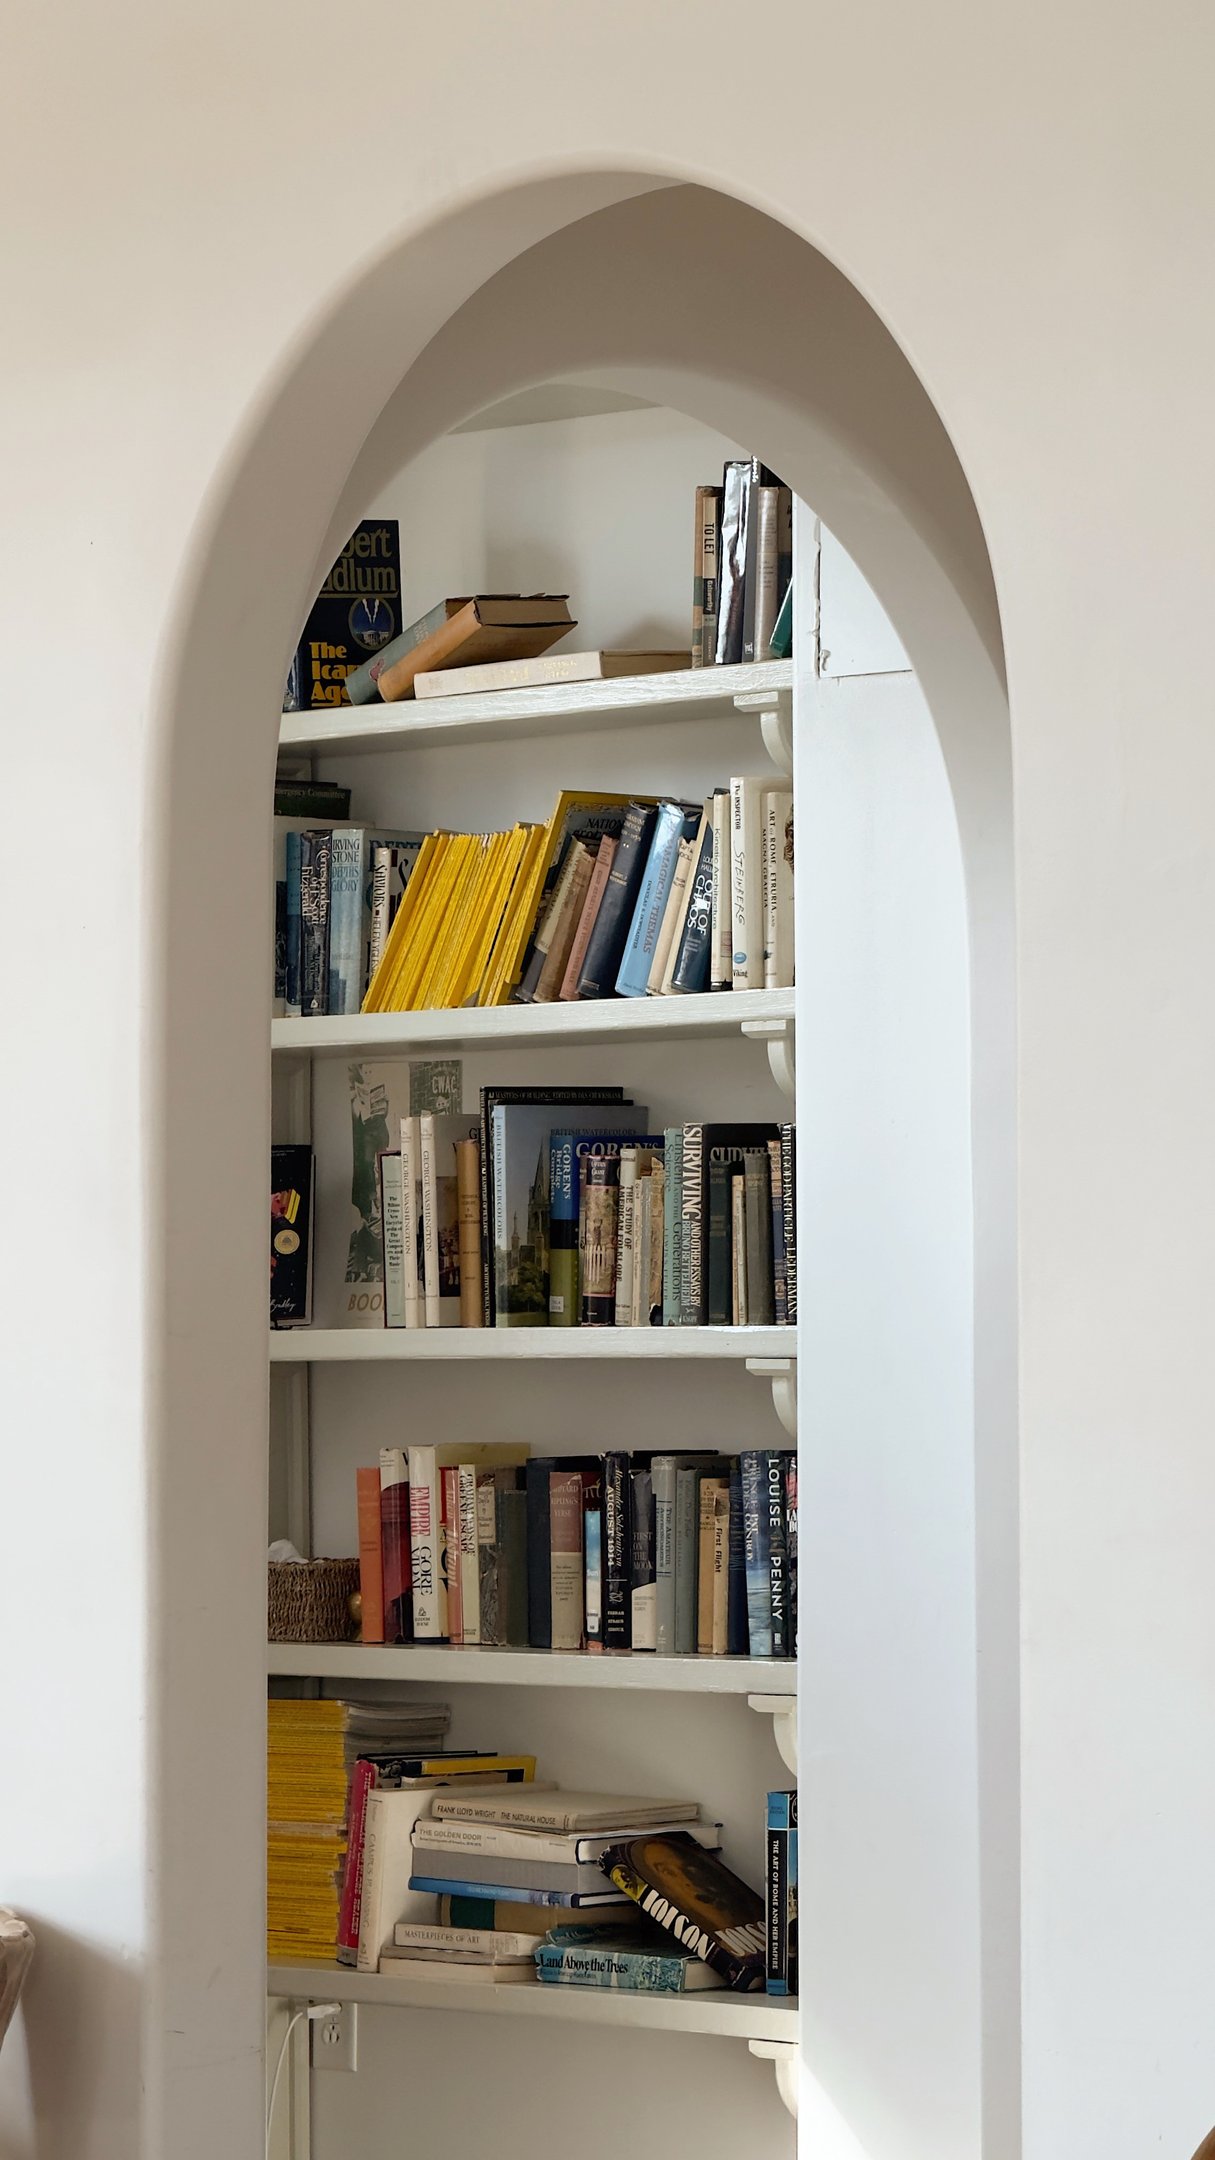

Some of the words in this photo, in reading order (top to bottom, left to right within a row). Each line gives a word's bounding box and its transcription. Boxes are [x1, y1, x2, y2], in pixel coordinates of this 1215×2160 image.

[704, 522, 715, 534] TO
[704, 537, 715, 555] LET
[309, 641, 347, 659] The
[332, 851, 360, 863] STONE
[333, 839, 360, 851] IRVING
[714, 828, 722, 864] Kinetic
[301, 866, 314, 917] Fitzgerald
[316, 850, 330, 925] Correspondence
[332, 880, 358, 892] GLORY
[701, 880, 714, 914] OUT
[713, 866, 721, 930] Architecture
[311, 899, 322, 925] Scott
[687, 875, 705, 929] CHAOS
[643, 904, 660, 953] THEMAS
[697, 914, 709, 935] OF
[733, 970, 748, 978] Viking
[431, 1075, 458, 1093] CWAC
[495, 1125, 503, 1165] BRITISH
[781, 1131, 791, 1154] THE
[423, 1150, 431, 1186] GEORGE
[563, 1144, 572, 1199] GOREN'S
[664, 1143, 674, 1193] Science
[674, 1134, 683, 1185] Einstein
[682, 1126, 703, 1220] SURVIVING
[782, 1156, 792, 1182] GOD
[625, 1185, 634, 1202] THE
[403, 1191, 411, 1254] WASHINGTON
[424, 1189, 433, 1252] WASHINGTON
[624, 1206, 634, 1235] STUDY
[782, 1185, 794, 1243] PARTICLE
[681, 1220, 691, 1250] BRUNO
[690, 1221, 701, 1236] AND
[624, 1237, 633, 1250] OF
[690, 1236, 701, 1264] OTHER
[672, 1220, 683, 1301] Generations
[681, 1251, 691, 1306] BETTELHEIM
[690, 1264, 701, 1292] ESSAYS
[784, 1249, 798, 1315] LEDERMAN
[347, 1293, 384, 1312] BOO
[690, 1293, 701, 1307] BY
[459, 1475, 468, 1515] GREENE
[615, 1467, 625, 1510] Alexander
[749, 1458, 759, 1509] PRINCE
[768, 1458, 780, 1527] LOUISE
[411, 1486, 431, 1537] EMPIRE
[606, 1485, 615, 1537] AUGUST
[460, 1518, 468, 1554] ESCAPE
[633, 1532, 652, 1541] FIRST
[665, 1526, 673, 1566] AMATEUR
[715, 1527, 723, 1546] First
[744, 1512, 753, 1561] CONROY
[607, 1539, 615, 1566] 1914
[634, 1551, 651, 1561] THE
[634, 1561, 654, 1570] MOON
[714, 1550, 723, 1573] Flight
[419, 1545, 433, 1597] GORE
[770, 1555, 783, 1621] PENNY
[437, 1805, 456, 1815] FRANK
[456, 1807, 473, 1816] LLOYD
[475, 1809, 496, 1819] WRIGHT
[501, 1811, 511, 1820] THE
[512, 1813, 535, 1823] NATURAL
[537, 1815, 556, 1825] HOUSE
[419, 1829, 432, 1837] THE
[433, 1831, 461, 1840] GOLDEN
[462, 1833, 482, 1841] DOOR
[772, 1840, 780, 1854] THE
[366, 1833, 376, 1874] CAMPUS
[772, 1856, 780, 1870] ART
[772, 1872, 780, 1882] OF
[772, 1883, 780, 1906] ROME
[642, 1889, 716, 1962] JOLSON
[772, 1907, 780, 1925] AND
[404, 1930, 453, 1942] MASTERPIECES
[467, 1935, 480, 1943] ART
[772, 1926, 780, 1940] HER
[540, 1953, 564, 1968] Land
[563, 1956, 590, 1971] Above
[591, 1958, 605, 1972] the
[605, 1959, 629, 1974] Trees
[772, 1942, 780, 1970] EMPIRE
